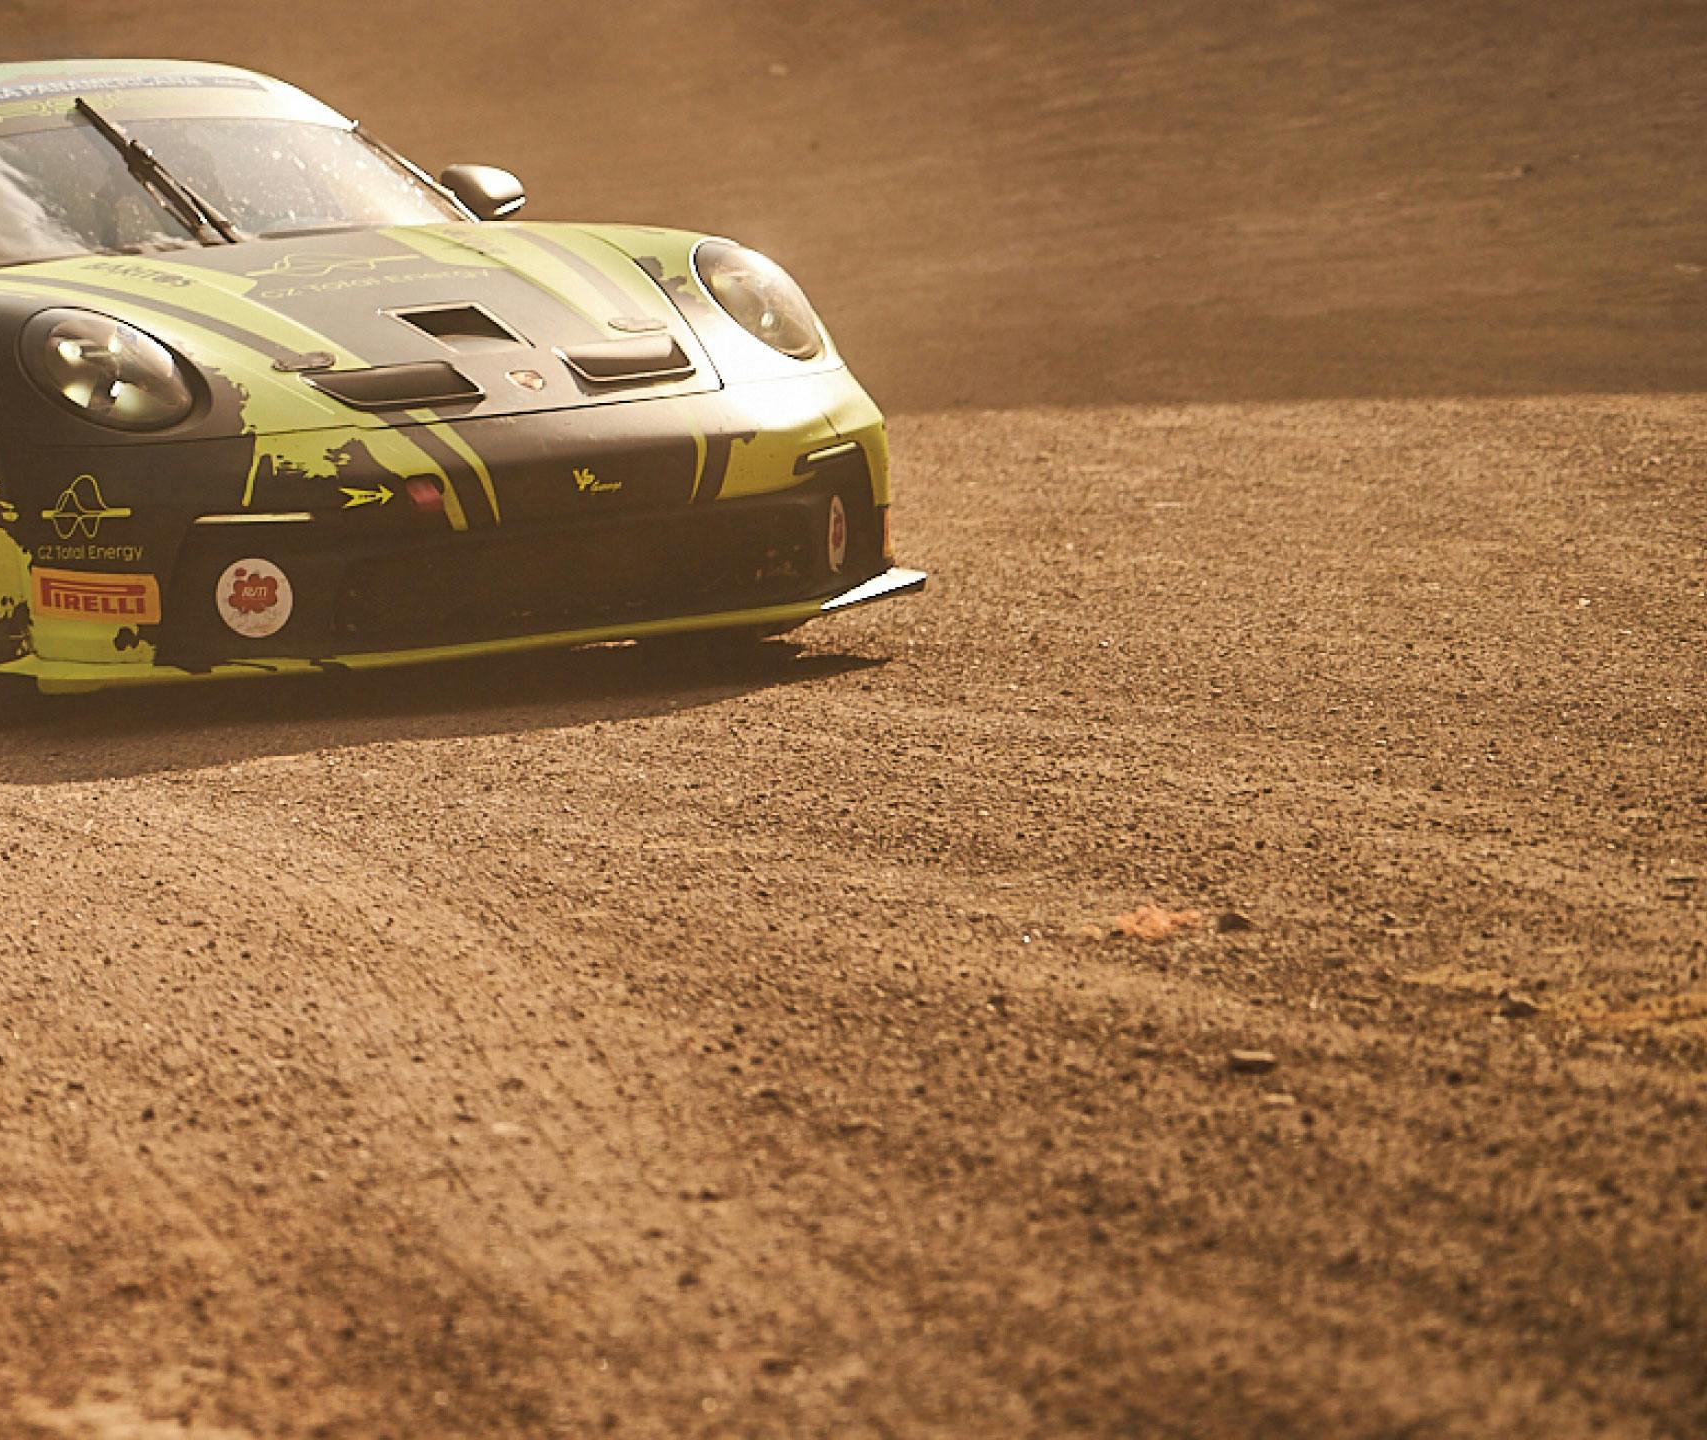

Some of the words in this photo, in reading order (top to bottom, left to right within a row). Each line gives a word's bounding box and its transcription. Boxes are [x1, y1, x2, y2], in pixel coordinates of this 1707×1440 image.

[21, 75, 202, 97] PANAMERICANA
[55, 544, 85, 561] Total
[87, 544, 145, 563] Energy
[40, 576, 147, 614] PIRELLI
